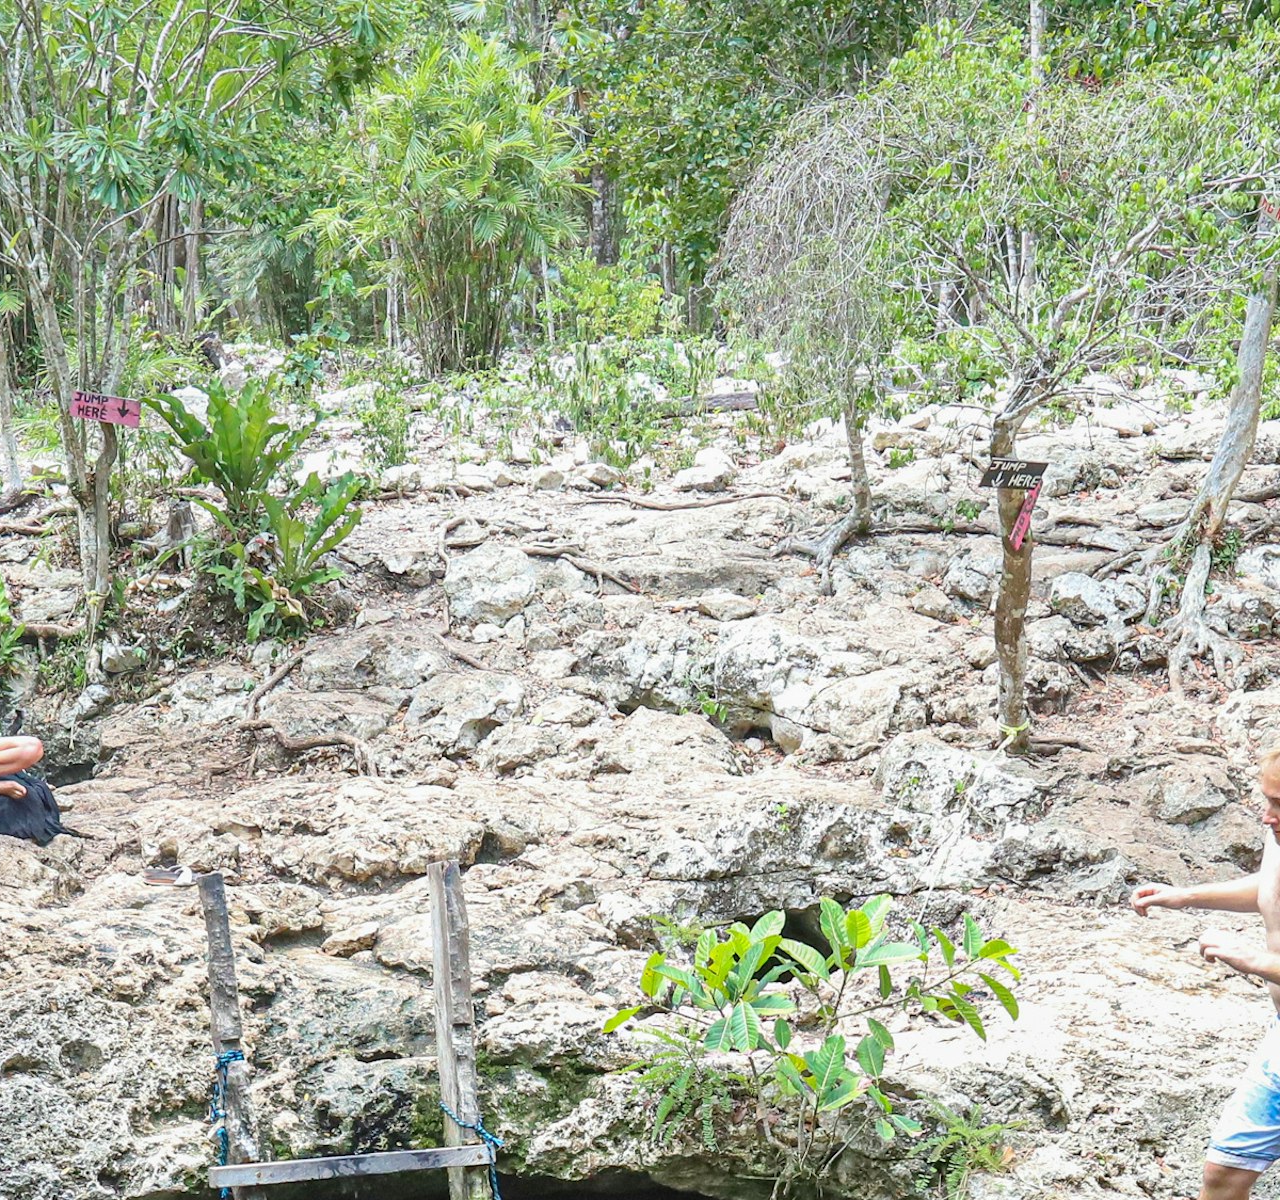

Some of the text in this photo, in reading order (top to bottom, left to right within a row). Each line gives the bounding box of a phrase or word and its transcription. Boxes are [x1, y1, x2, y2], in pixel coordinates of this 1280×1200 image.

[74, 391, 109, 405] JUMP
[77, 405, 108, 421] HERE
[990, 461, 1027, 472] JUMP
[1008, 474, 1042, 488] HERE
